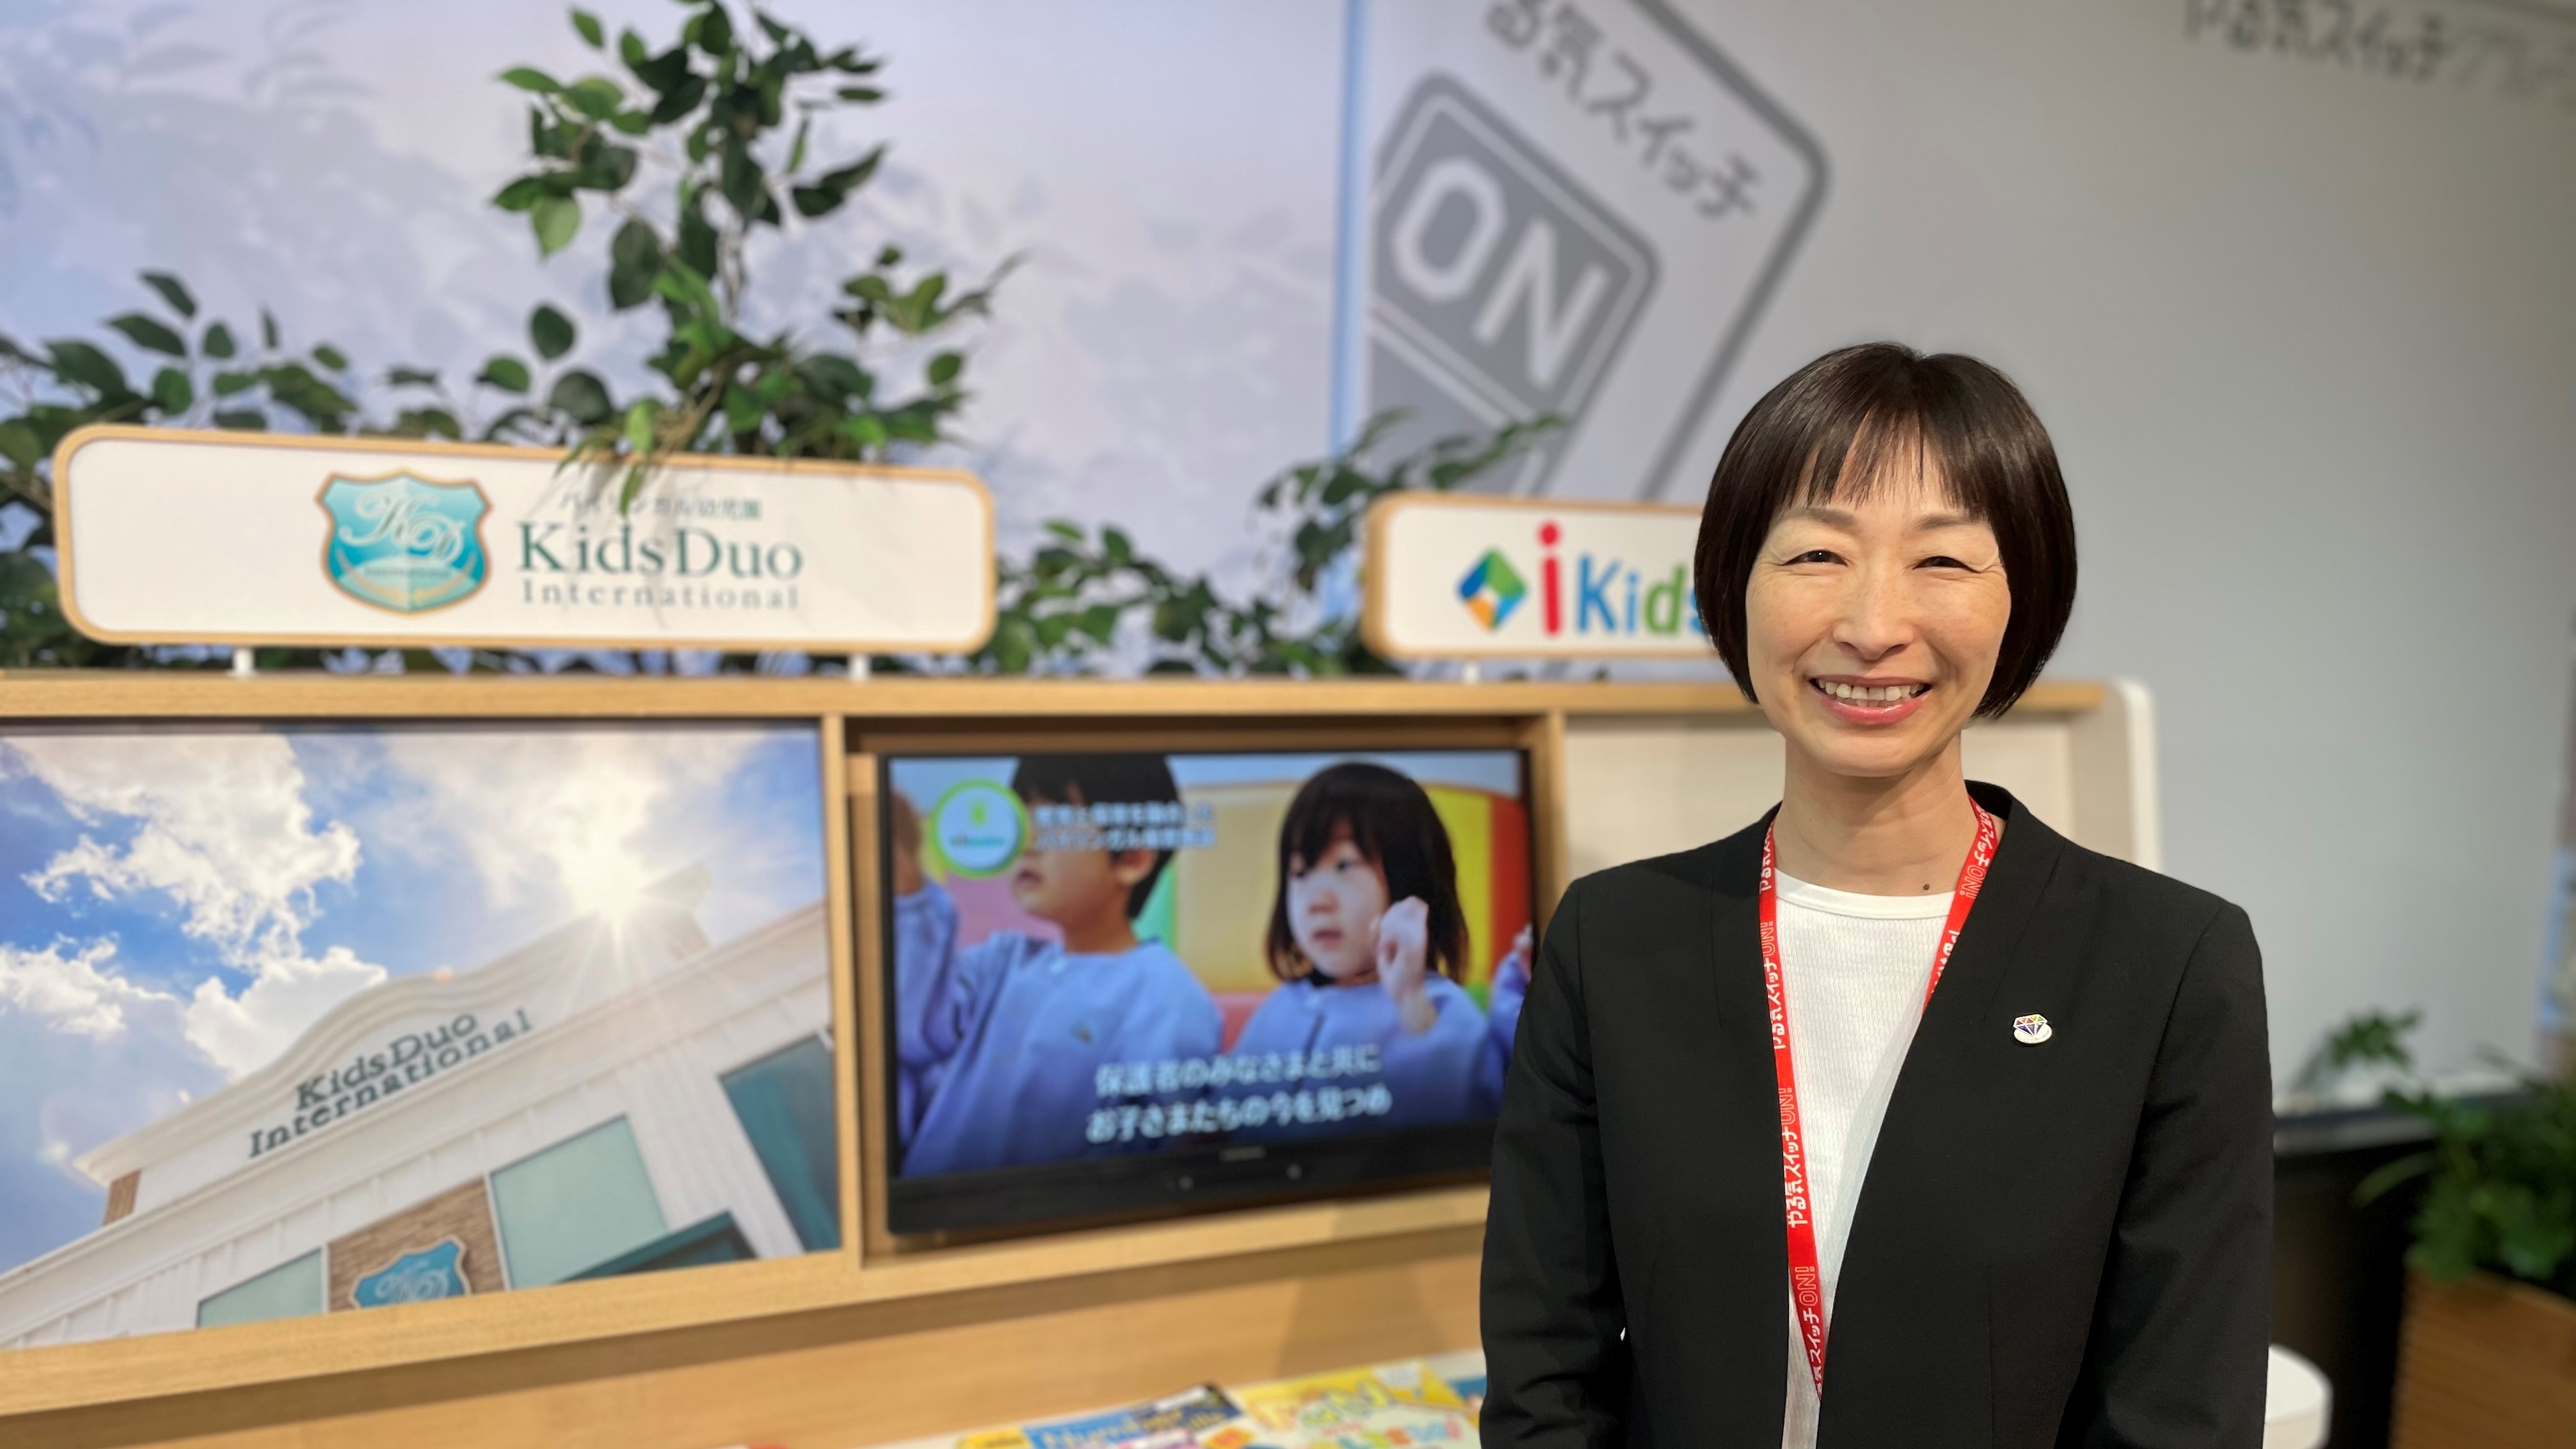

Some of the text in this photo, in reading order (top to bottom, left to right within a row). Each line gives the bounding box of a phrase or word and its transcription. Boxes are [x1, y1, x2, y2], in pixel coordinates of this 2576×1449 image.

[1390, 155, 1610, 391] ON
[516, 521, 804, 581] KidsDuo
[522, 578, 801, 611] International
[249, 1008, 532, 1158] International
[295, 1013, 477, 1112] KidsDuo
[1086, 1084, 1392, 1143] お子さまたちの今を見つめ
